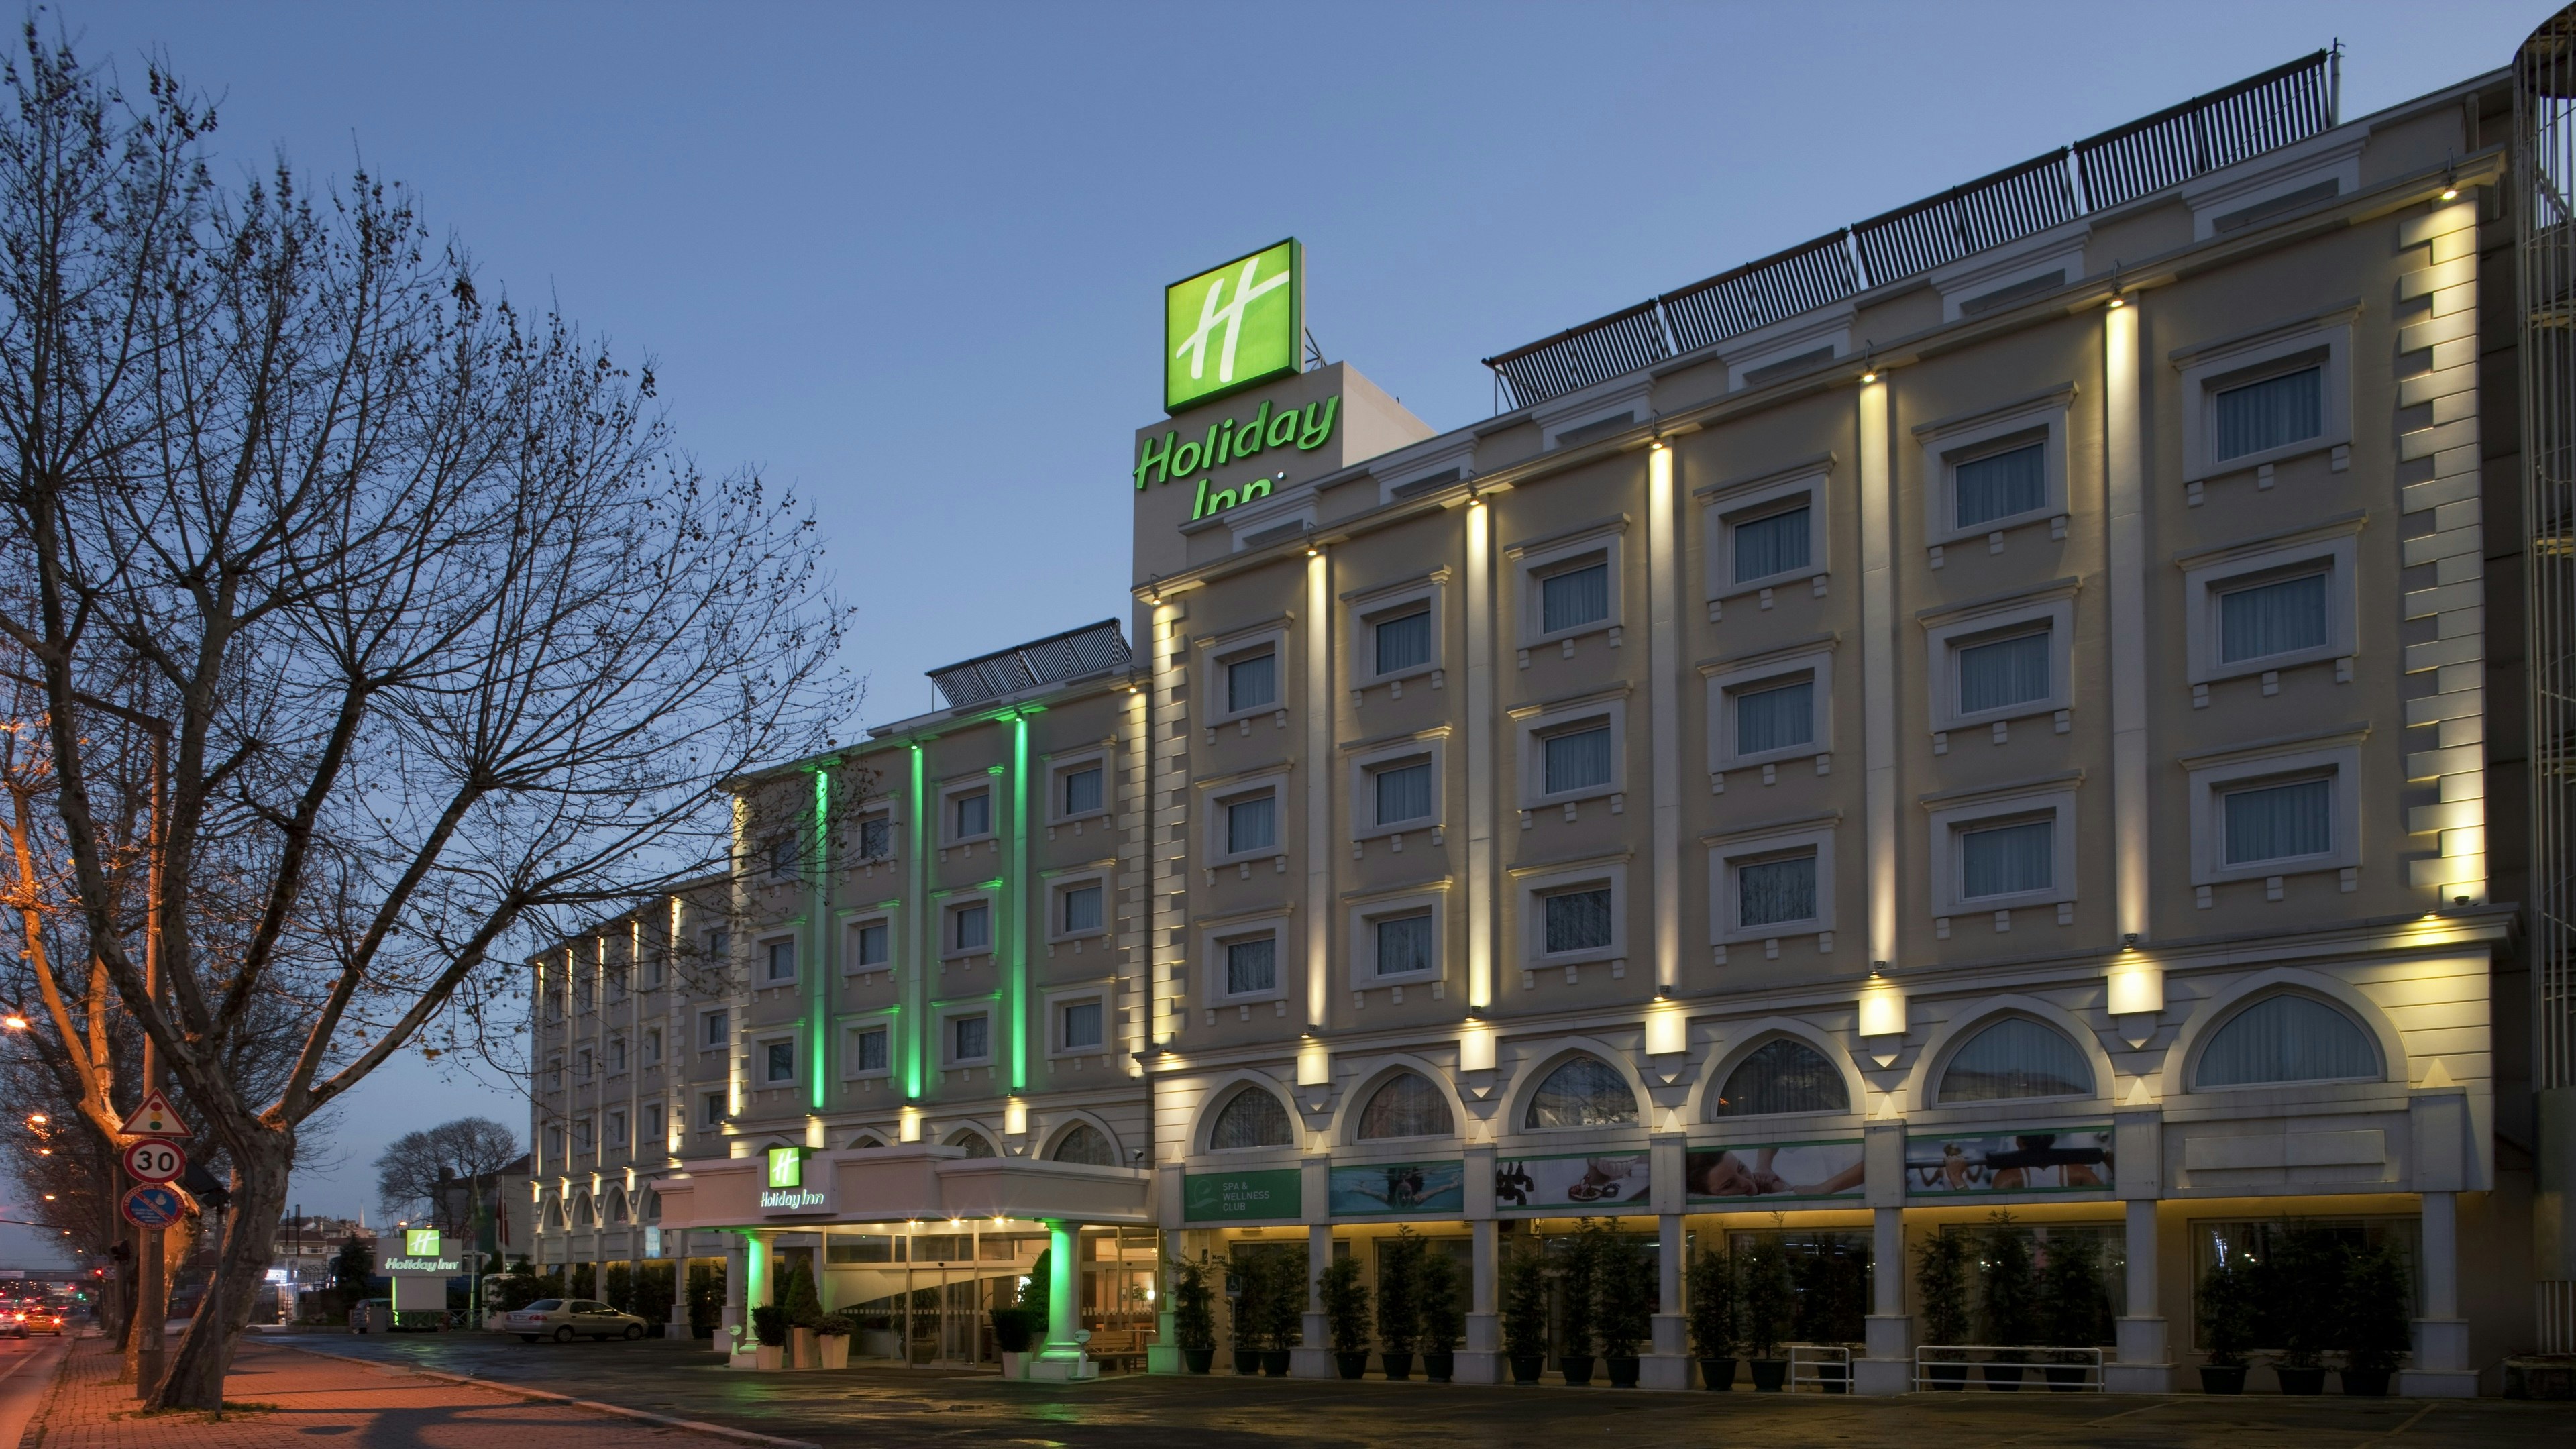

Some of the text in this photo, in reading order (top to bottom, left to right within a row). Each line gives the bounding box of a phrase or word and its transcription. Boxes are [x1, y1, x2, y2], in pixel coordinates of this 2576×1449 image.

[1133, 395, 1340, 490] Holiday
[1191, 478, 1275, 521] Inn
[137, 1150, 174, 1172] 30
[1222, 1181, 1248, 1191] SPA &
[760, 1189, 824, 1210] Holiday Inn
[1222, 1191, 1270, 1201] WELLNESS
[1223, 1202, 1246, 1212] CLUB
[384, 1258, 458, 1272] Holiday Inn
